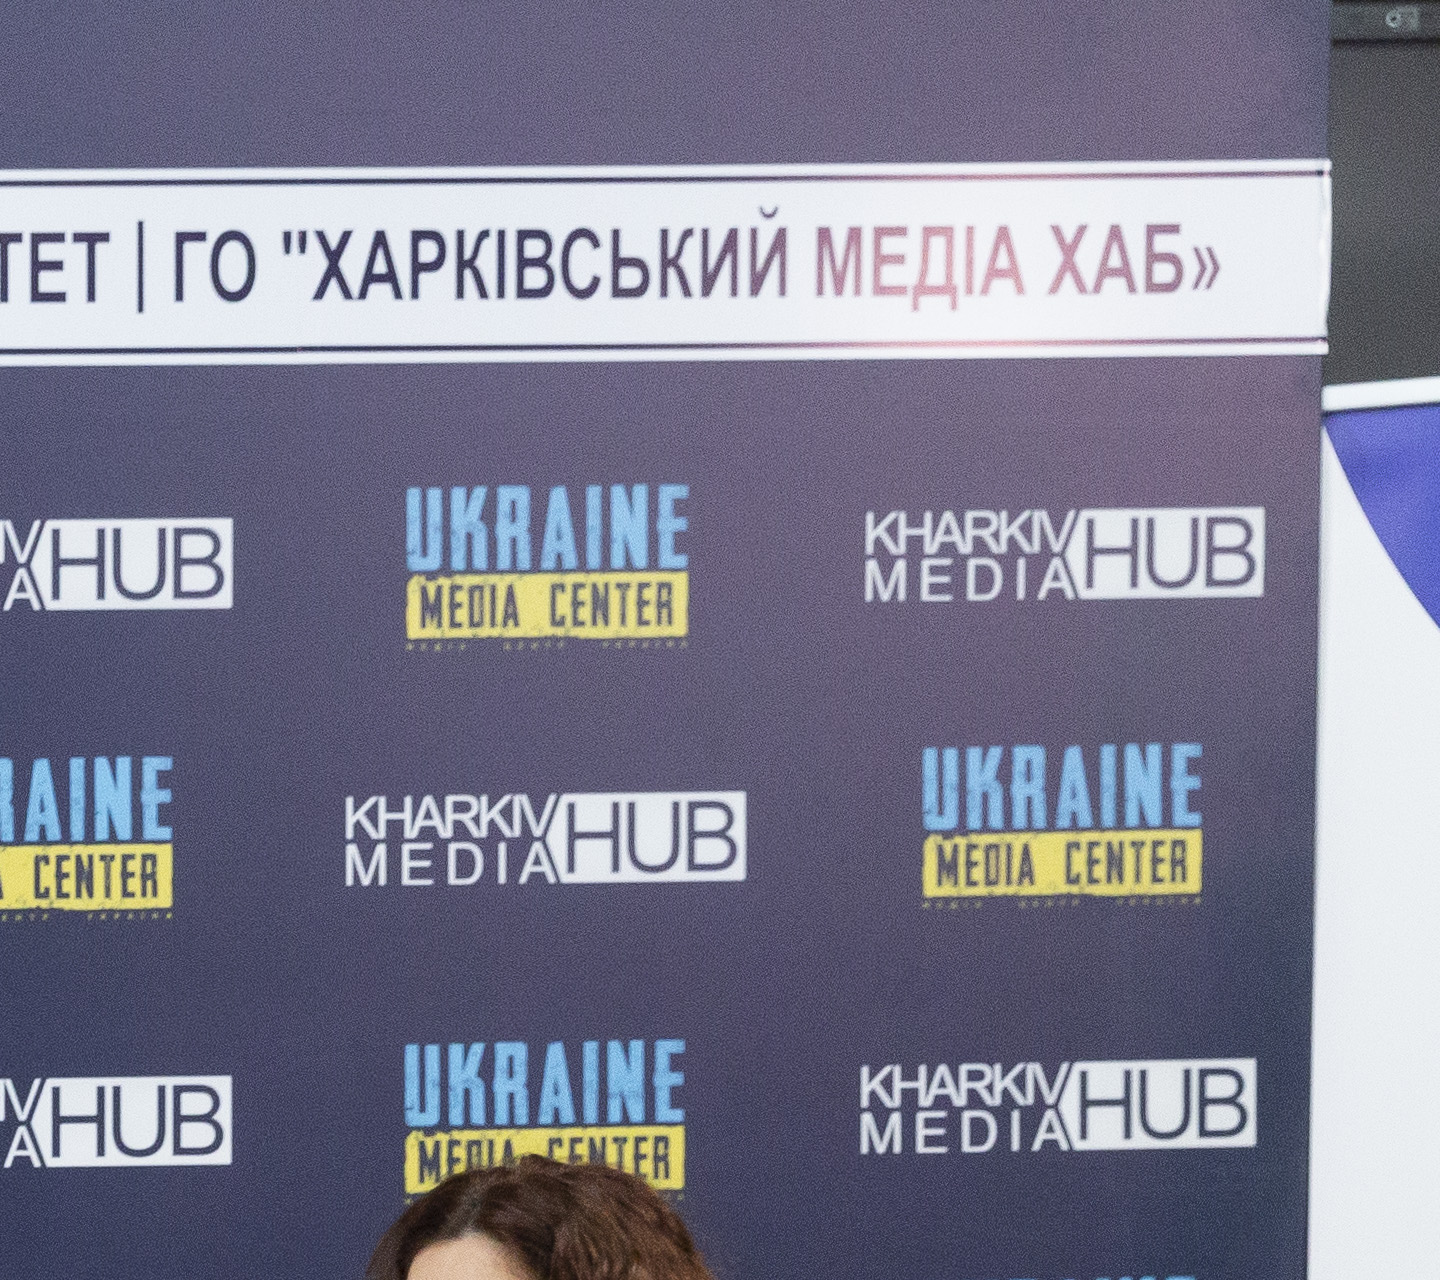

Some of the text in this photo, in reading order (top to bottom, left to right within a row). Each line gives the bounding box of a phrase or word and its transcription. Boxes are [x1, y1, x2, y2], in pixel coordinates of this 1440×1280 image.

[175, 230, 256, 302] ГО
[283, 208, 786, 301] "ХАРКІВСЬКИЙ
[814, 225, 1025, 312] МЕДІА
[406, 483, 688, 572] UKRAINE
[866, 510, 1075, 555] KHARKIV
[1086, 516, 1256, 589] HUB
[52, 527, 224, 600] HUB
[865, 557, 1074, 601] MEDIA
[420, 582, 672, 629] MEDIA CENTER
[346, 794, 556, 839] KHARKIV
[922, 742, 1202, 831] UKRAINE
[346, 841, 556, 886] MEDIA
[567, 801, 737, 873] HUB
[936, 839, 1187, 887] MEDIA CENTER
[34, 853, 158, 899] CENTER
[404, 1039, 685, 1127] UKRAINE
[861, 1062, 1069, 1108] KHARKIV
[1080, 1068, 1248, 1140] HUB
[52, 1085, 223, 1157] HUB
[861, 1109, 1069, 1154] MEDIA
